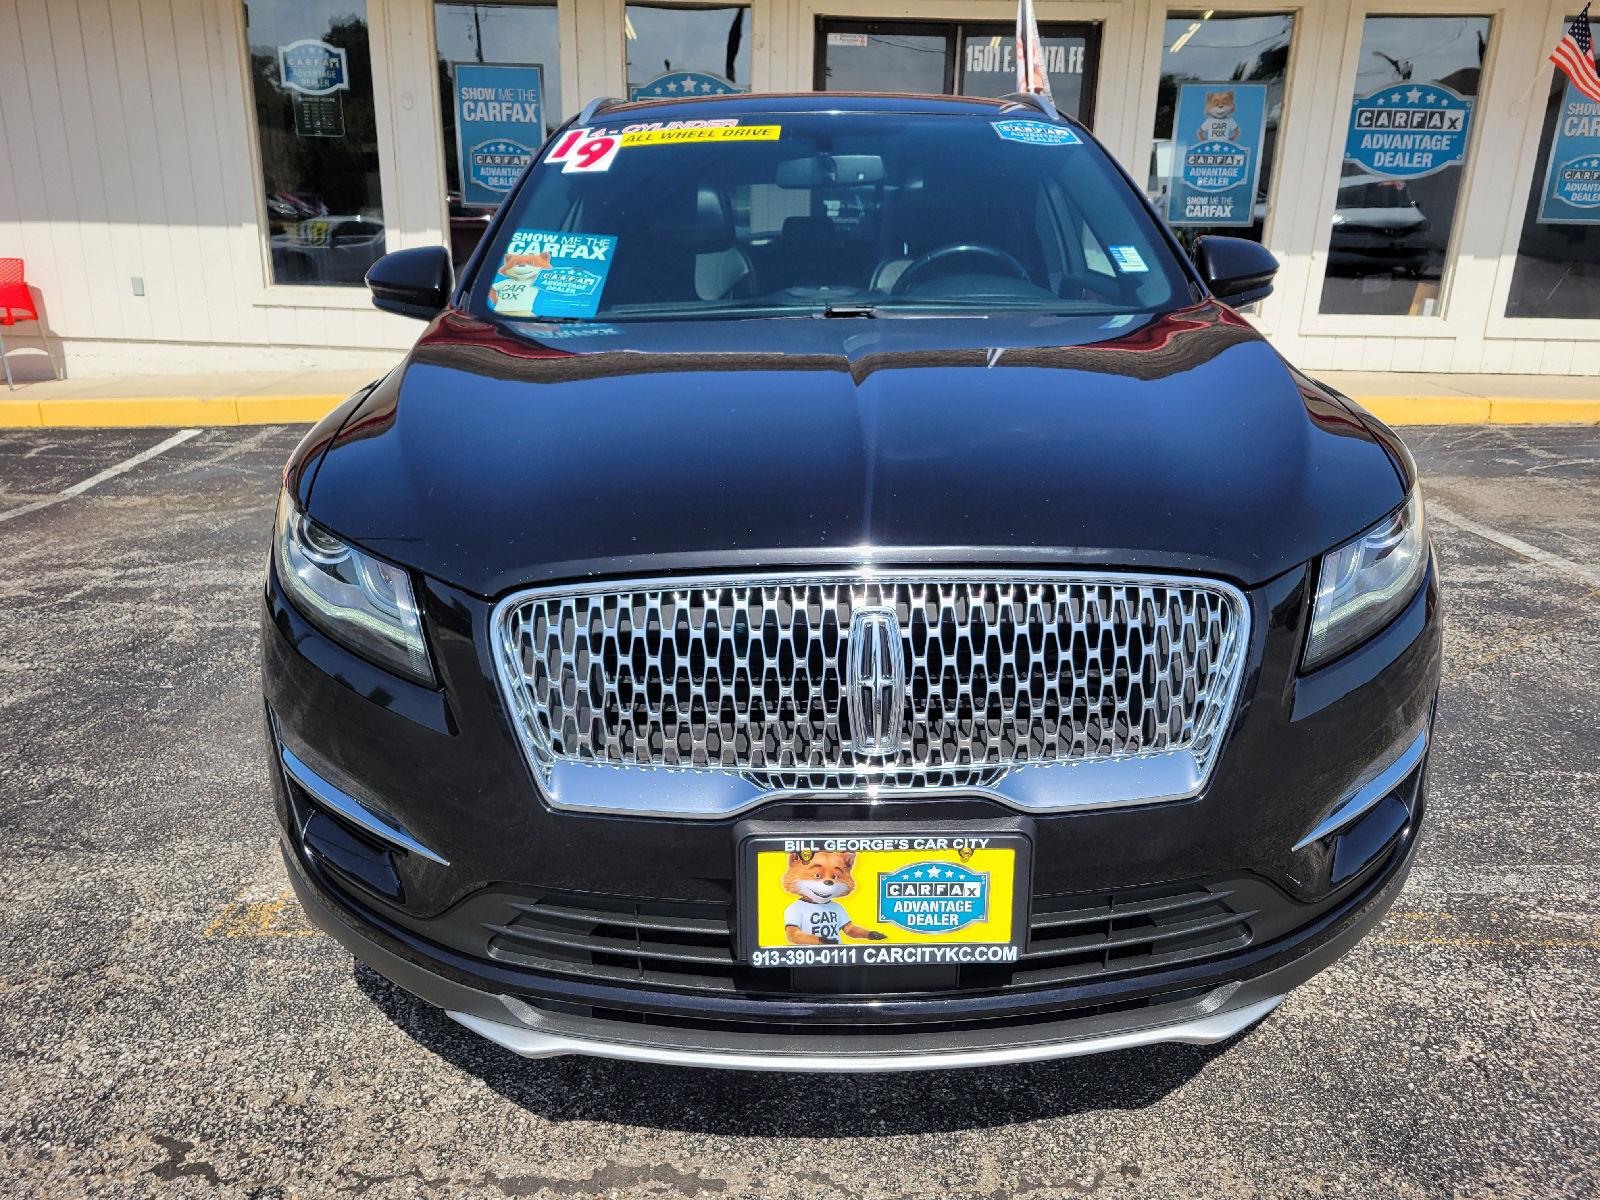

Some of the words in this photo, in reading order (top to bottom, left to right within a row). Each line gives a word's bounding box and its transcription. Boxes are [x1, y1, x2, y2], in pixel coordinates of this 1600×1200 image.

[966, 45, 1000, 72] 1501
[1003, 45, 1016, 73] E.
[1041, 45, 1066, 73] NTA
[1068, 46, 1085, 74] FE
[461, 87, 496, 100] SHOW
[499, 89, 513, 101] ME
[517, 89, 536, 102] THE
[463, 101, 538, 123] CARFAX
[621, 118, 740, 134] CYLINDER
[1360, 111, 1460, 130] CARFAX
[623, 133, 654, 143] ALL
[661, 130, 716, 139] WHEEL
[721, 128, 774, 137] DRIVE
[1360, 134, 1452, 150] ADVANTAGE
[475, 155, 530, 165] CARFAX
[1188, 156, 1244, 166] CARFAX
[1373, 151, 1434, 168] DEALER
[480, 167, 524, 176] ADVANTAG
[1189, 167, 1239, 177] ADVANTAGE
[1196, 177, 1229, 187] DEALER
[1186, 195, 1208, 206] SHOW
[1209, 197, 1219, 206] ME
[1221, 197, 1233, 206] THE
[1185, 206, 1233, 218] CARFAX
[512, 232, 559, 244] SHOW
[561, 236, 582, 246] ME
[587, 237, 611, 247] THE
[507, 241, 608, 261] CARFAX
[541, 279, 588, 291] ADVANTAGE
[546, 285, 577, 295] DEALER
[784, 840, 820, 851] BILL
[824, 839, 909, 852] GEORGE'S
[913, 839, 948, 850] CAR
[952, 838, 990, 850] CITY
[888, 884, 977, 897] CARFAX
[893, 900, 973, 913] ADVANTAGE
[810, 911, 838, 925] CAR
[907, 913, 959, 926] DEALER
[811, 924, 839, 938] FOX
[752, 948, 857, 966] 913-390-0111
[863, 946, 1018, 964] CARCITYKC.COM
